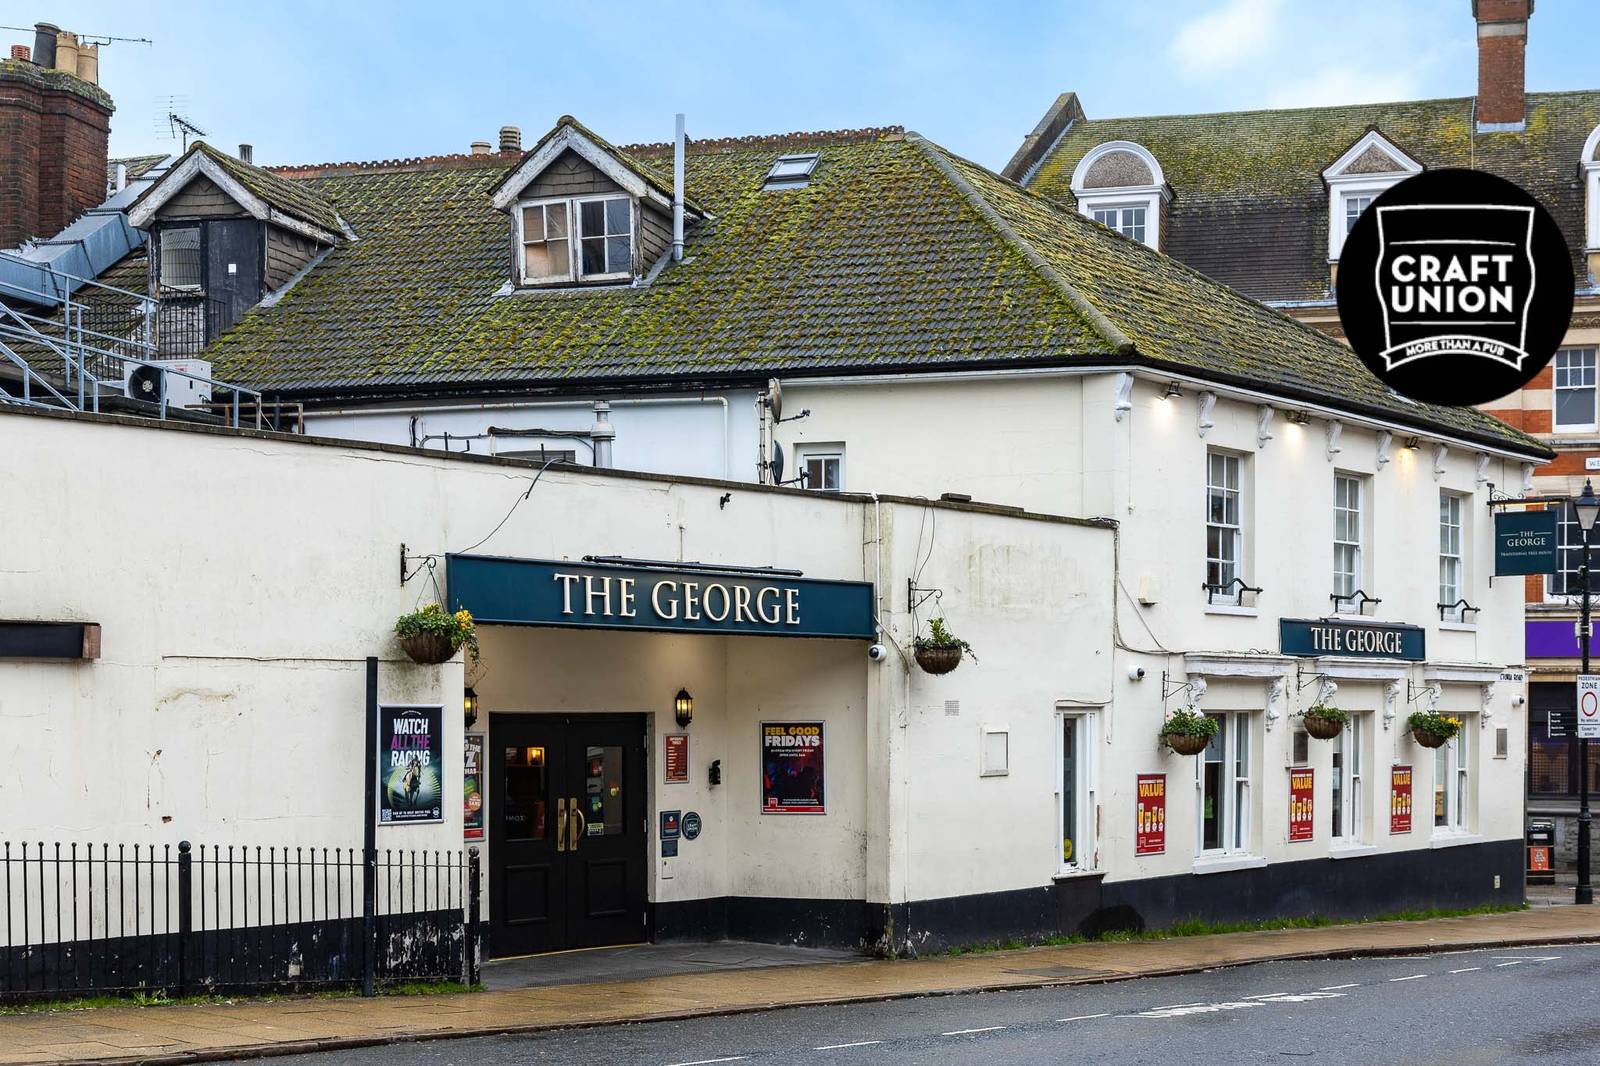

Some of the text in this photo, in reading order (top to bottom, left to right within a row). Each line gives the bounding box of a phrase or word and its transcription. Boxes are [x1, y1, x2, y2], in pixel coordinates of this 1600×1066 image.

[1519, 530, 1535, 538] THE
[1506, 537, 1546, 547] GEORGE
[553, 572, 802, 625] THE GEORGE
[1311, 627, 1402, 654] THE GEORGE
[1581, 682, 1598, 690] ZONE
[393, 718, 429, 735] WATCH
[764, 726, 820, 736] FEEL GOOD
[391, 735, 430, 750] ALL THE
[764, 735, 820, 747] FRIDAYS
[391, 750, 430, 767] RACING
[1292, 776, 1313, 790] VALUE
[1393, 773, 1411, 786] VALUE
[1139, 783, 1164, 798] VALUE
